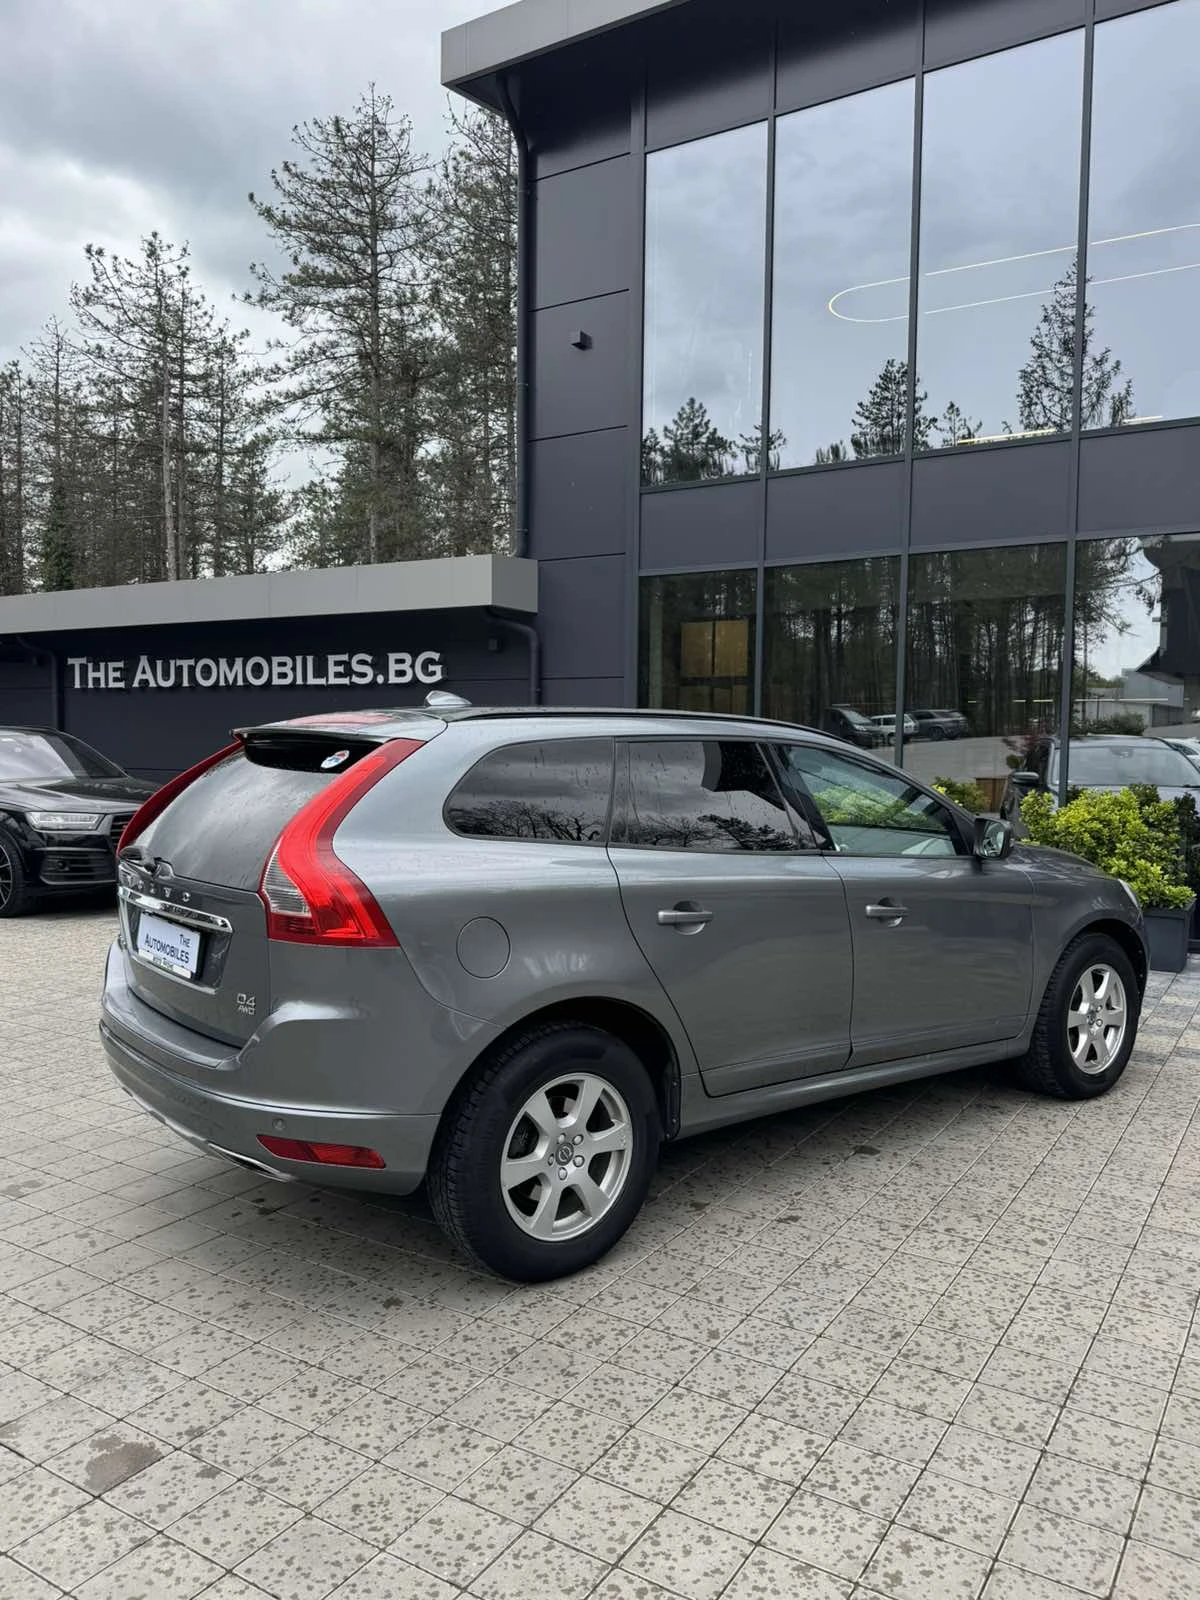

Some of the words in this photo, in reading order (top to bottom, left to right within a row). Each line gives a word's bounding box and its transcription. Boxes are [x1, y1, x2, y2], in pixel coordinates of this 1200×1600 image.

[67, 657, 126, 689] THE
[132, 651, 443, 688] AUTOMOBILES.BG
[144, 933, 190, 964] AUTOMOBILES
[179, 934, 191, 948] THE
[237, 992, 255, 1007] D4
